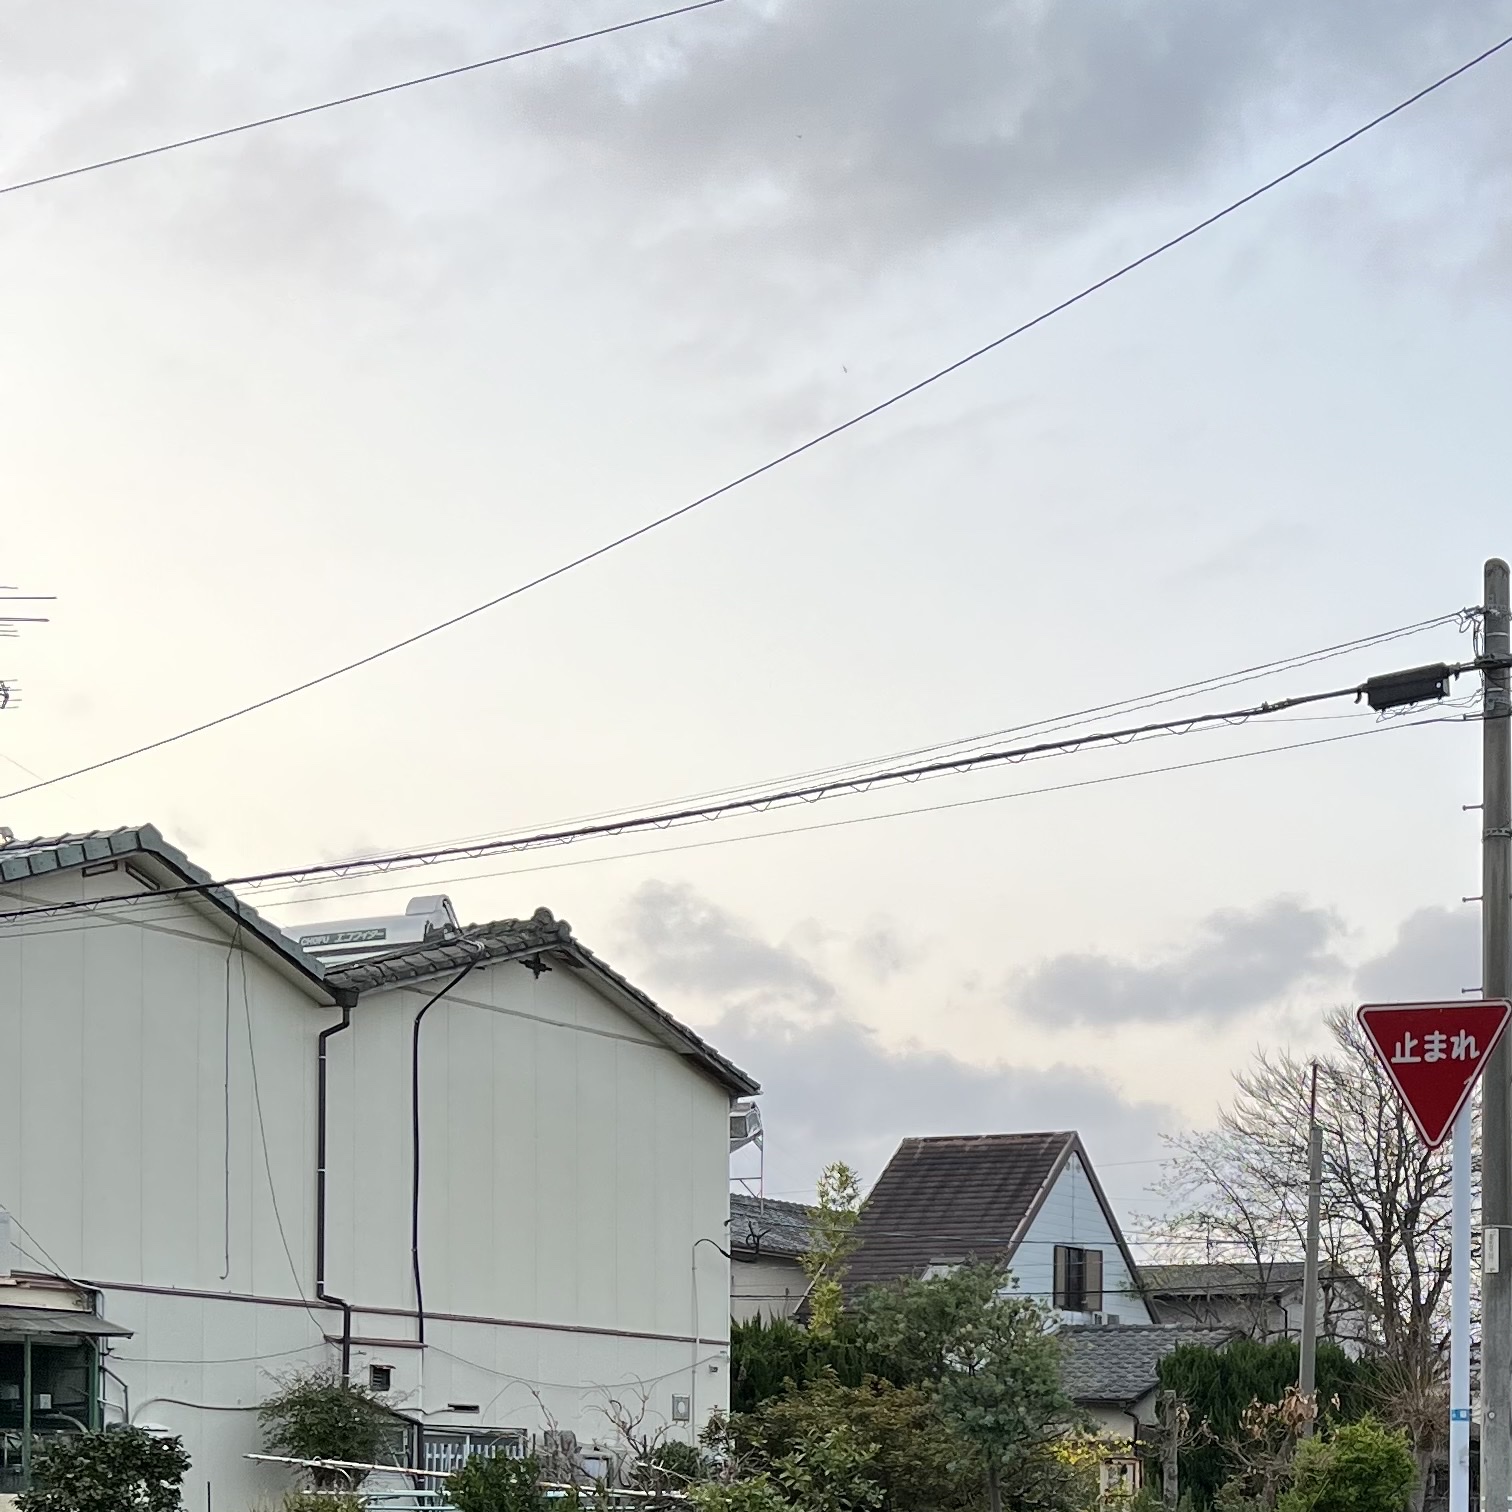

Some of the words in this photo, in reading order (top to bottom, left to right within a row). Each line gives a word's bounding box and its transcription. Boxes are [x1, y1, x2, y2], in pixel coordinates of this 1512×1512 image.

[301, 935, 330, 946] CHOFU
[1391, 1029, 1480, 1064] 止まれ
